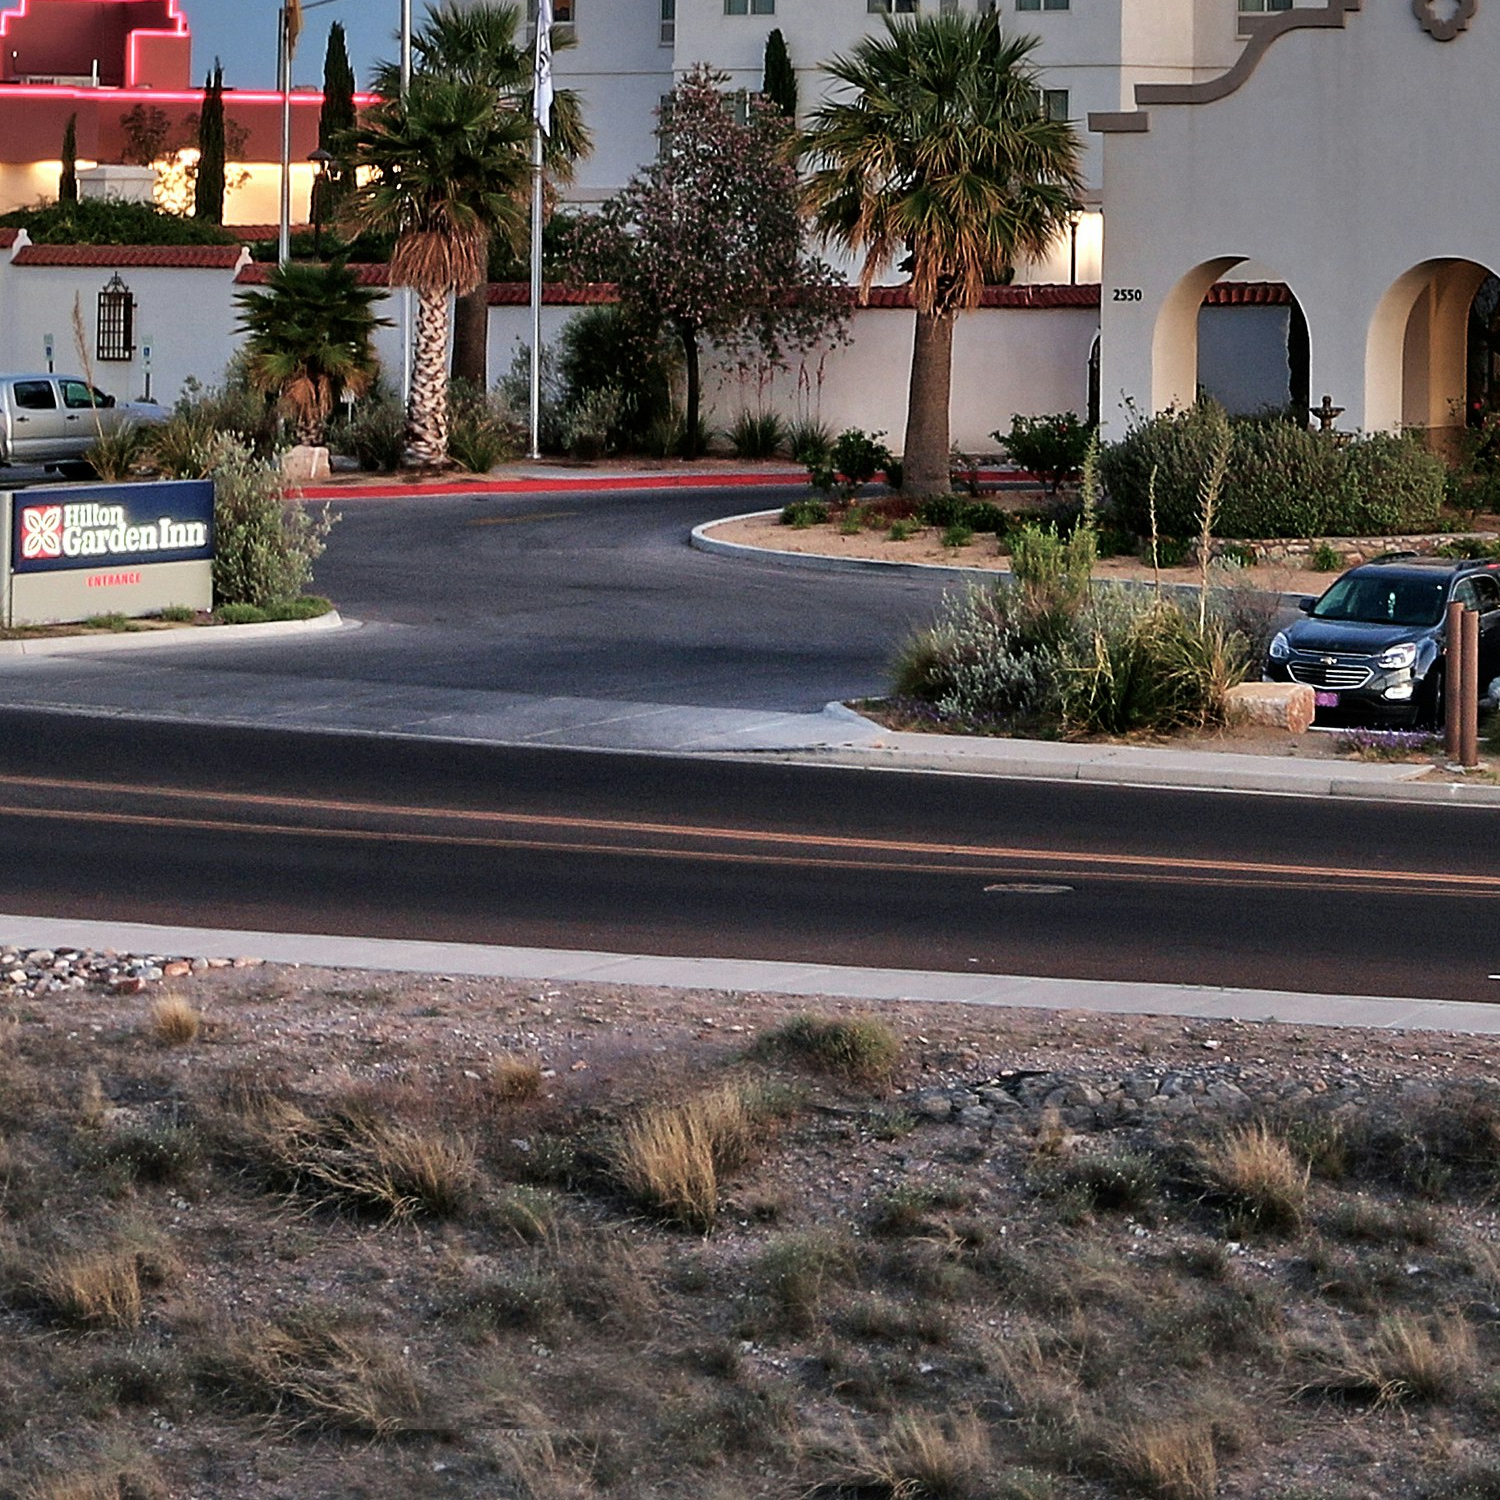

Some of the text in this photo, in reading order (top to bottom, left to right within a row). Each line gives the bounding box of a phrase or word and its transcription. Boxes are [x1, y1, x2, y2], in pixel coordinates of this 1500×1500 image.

[1113, 289, 1142, 301] 2550
[63, 504, 123, 527] Hilton
[62, 518, 207, 556] Garden Inn
[86, 572, 141, 588] ENTRANCE
